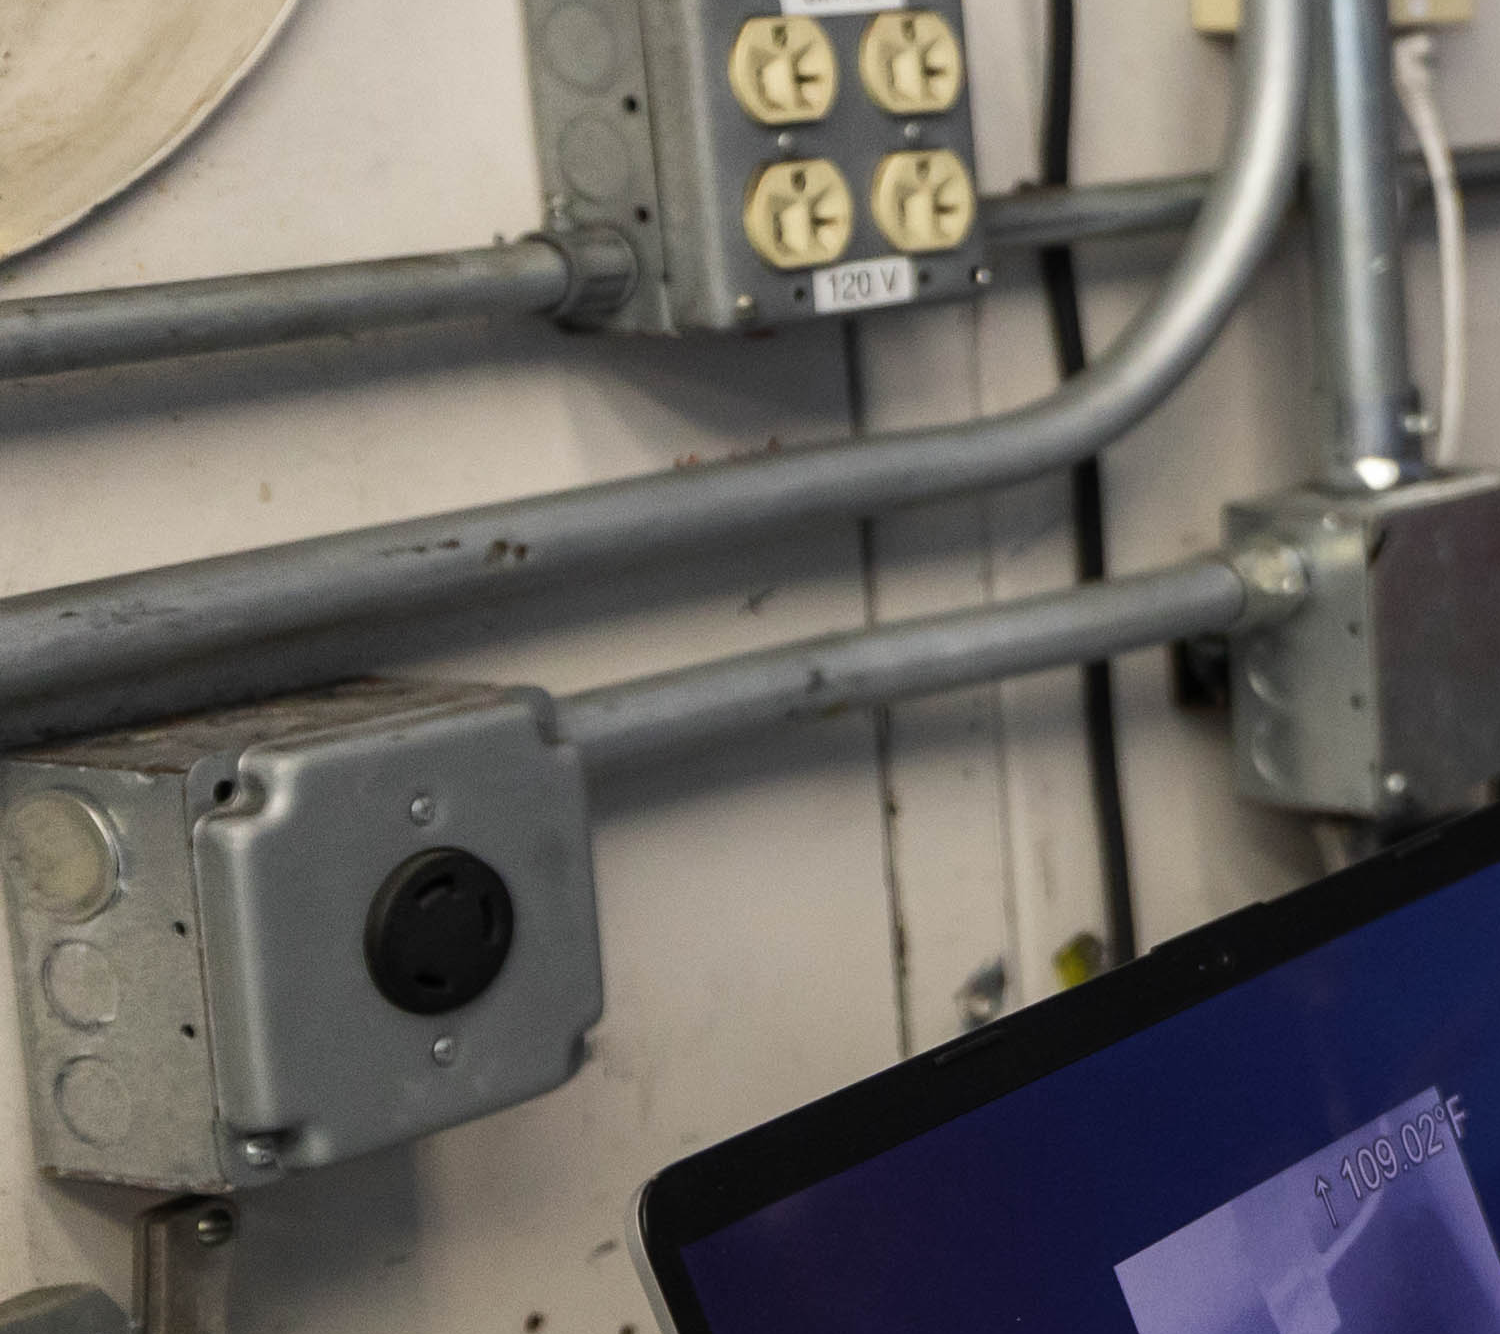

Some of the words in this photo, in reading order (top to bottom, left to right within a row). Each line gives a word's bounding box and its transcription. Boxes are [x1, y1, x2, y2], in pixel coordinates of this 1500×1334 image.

[827, 271, 872, 303] 120
[878, 270, 900, 293] V
[1341, 1095, 1465, 1199] 109.02°F
